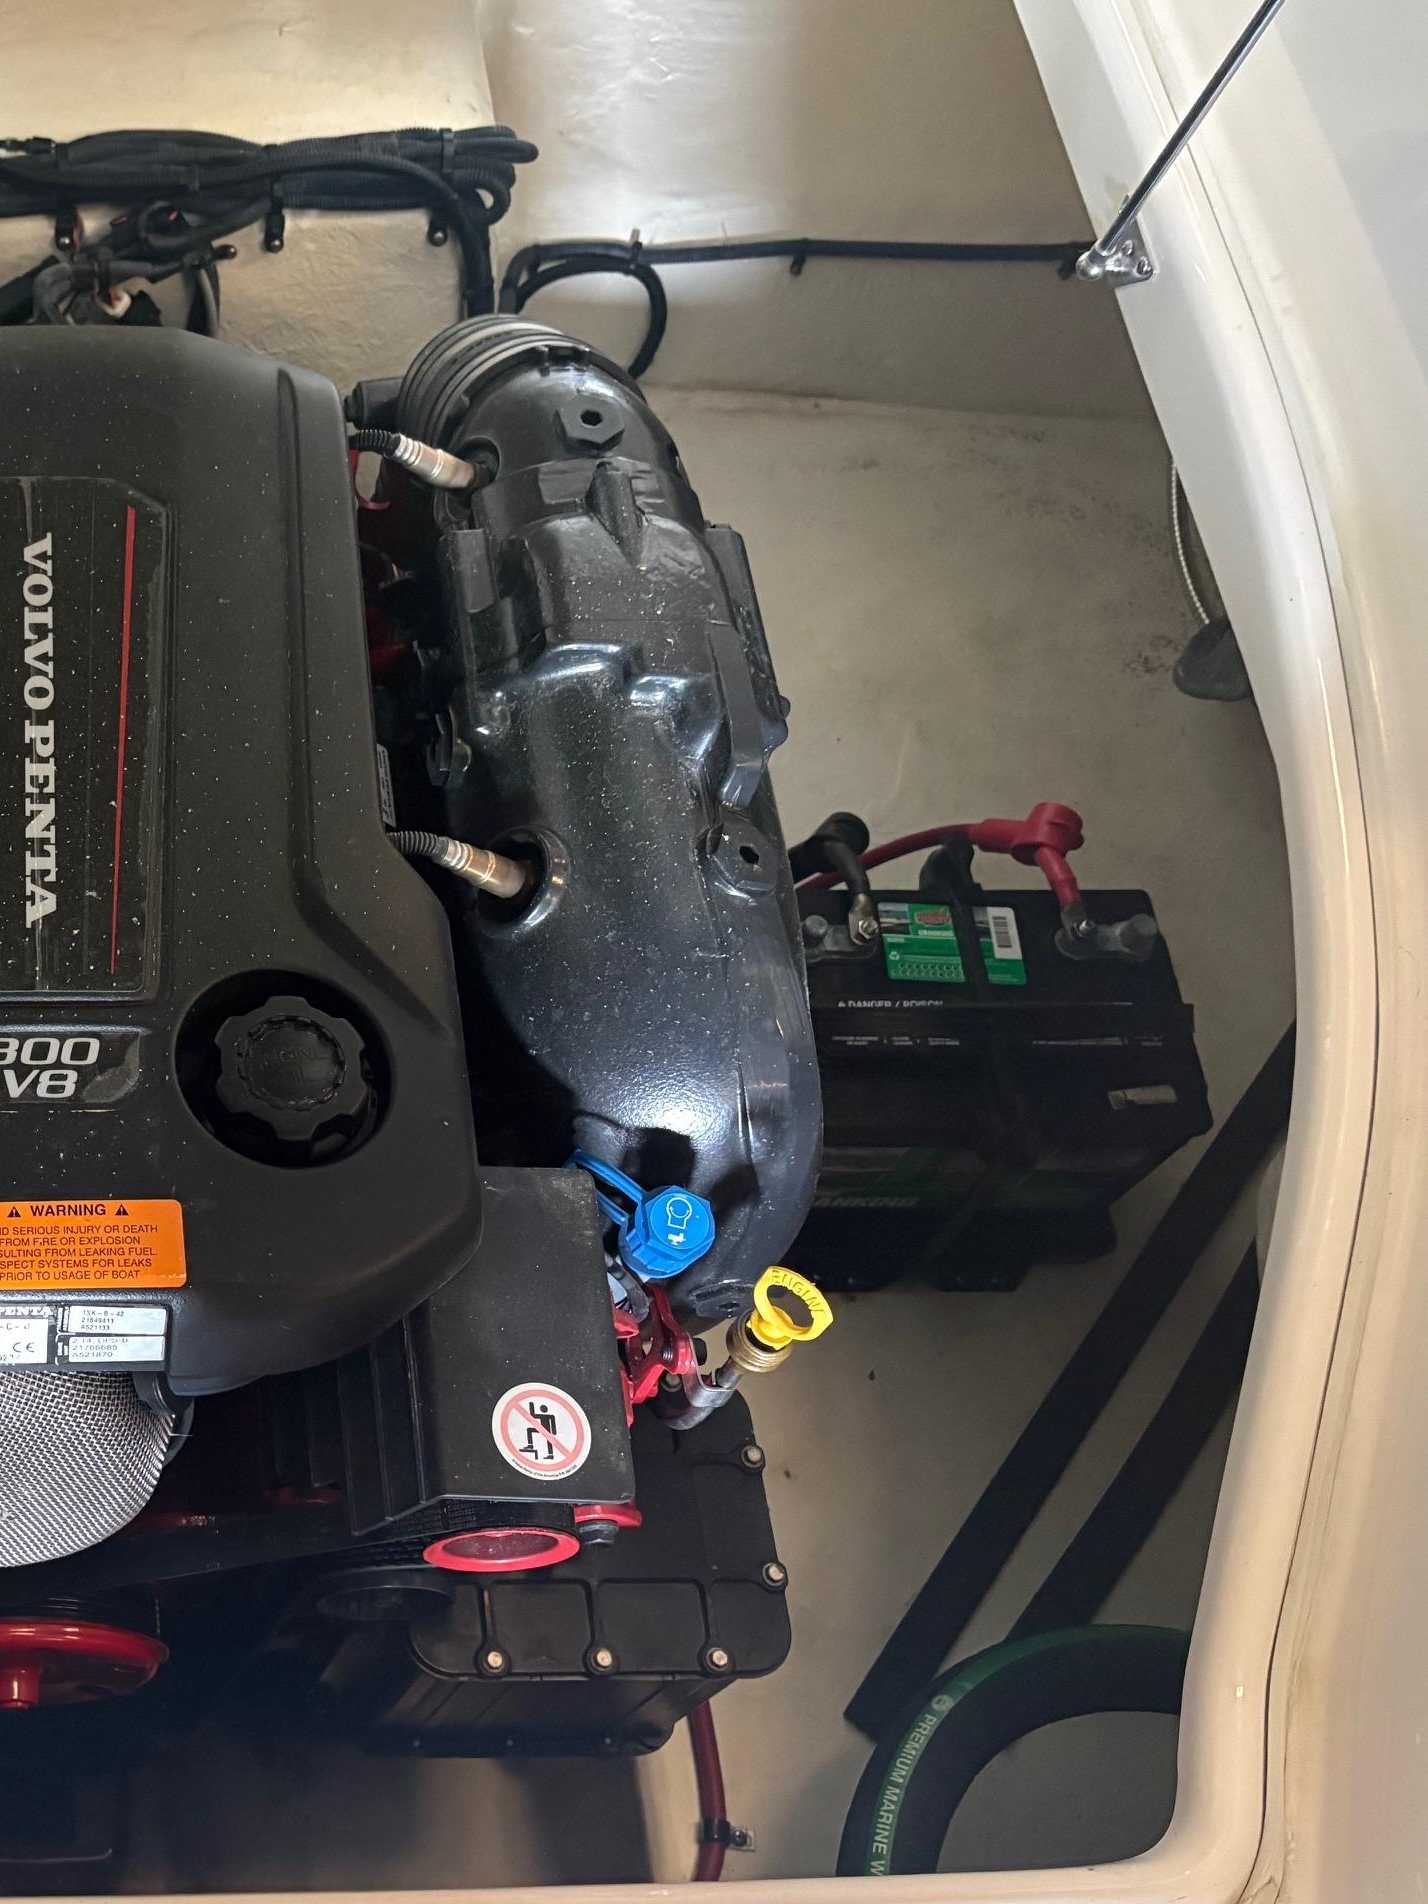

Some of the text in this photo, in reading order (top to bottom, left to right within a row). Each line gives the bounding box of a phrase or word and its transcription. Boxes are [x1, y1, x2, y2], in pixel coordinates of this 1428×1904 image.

[22, 533, 58, 928] VOLVO PENTA
[3, 1070, 79, 1099] V8
[30, 1204, 107, 1217] WARNING
[12, 1226, 60, 1235] SERIOUS
[63, 1225, 101, 1235] INJURY
[103, 1224, 120, 1233] OR
[123, 1224, 158, 1233] DEATH
[59, 1237, 76, 1245] OR
[79, 1236, 141, 1245] EXPLOSION
[45, 1248, 76, 1257] FROM
[79, 1247, 125, 1256] LEAKING
[38, 1259, 89, 1268] SYSTEMS
[92, 1259, 114, 1268] FOR
[117, 1258, 152, 1267] LEAKS
[0, 1270, 140, 1281] PRIOR TO USAGE OF BOAT
[889, 1713, 937, 1783] PREMIUM
[872, 1785, 900, 1855] MARINE
